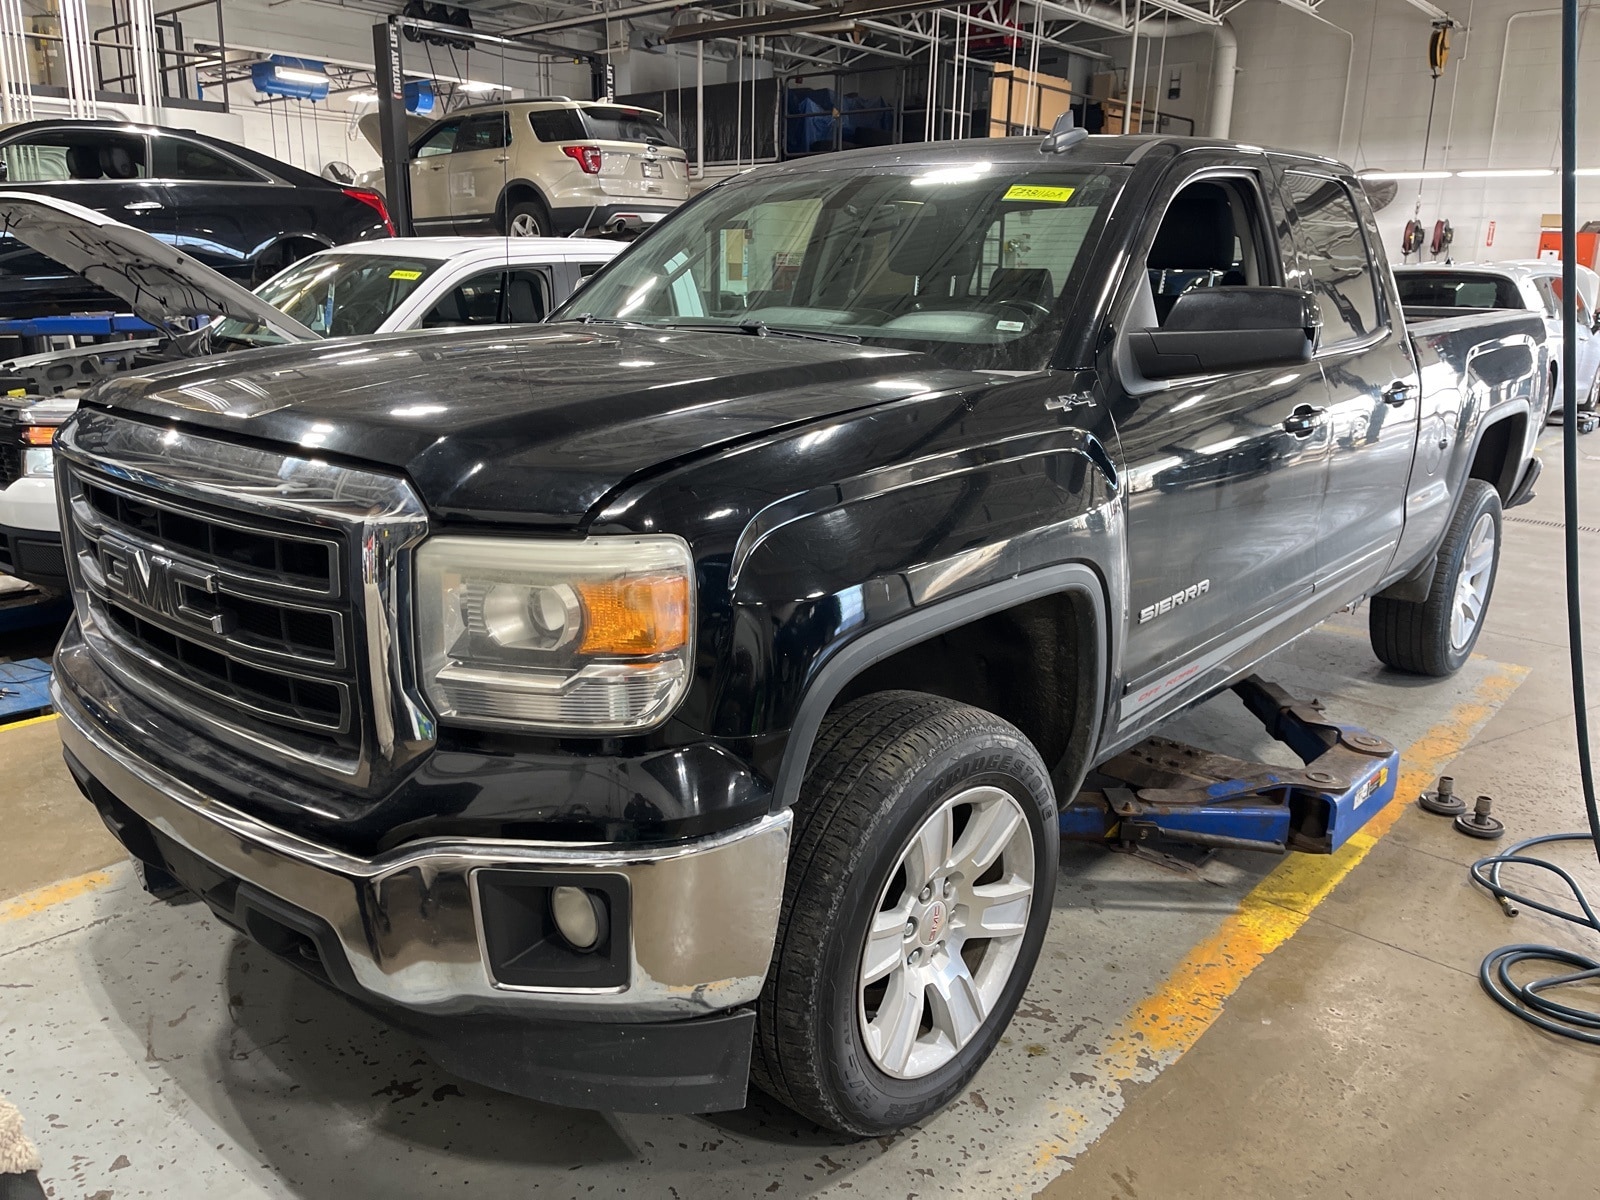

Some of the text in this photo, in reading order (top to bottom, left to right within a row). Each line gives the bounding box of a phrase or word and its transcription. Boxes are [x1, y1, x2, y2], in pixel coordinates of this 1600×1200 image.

[389, 24, 402, 93] ROTARY LIFT
[98, 534, 223, 634] GMC
[1138, 579, 1210, 624] SIERRA
[928, 754, 1053, 822] BRIDGESTONE
[929, 905, 940, 941] GMC
